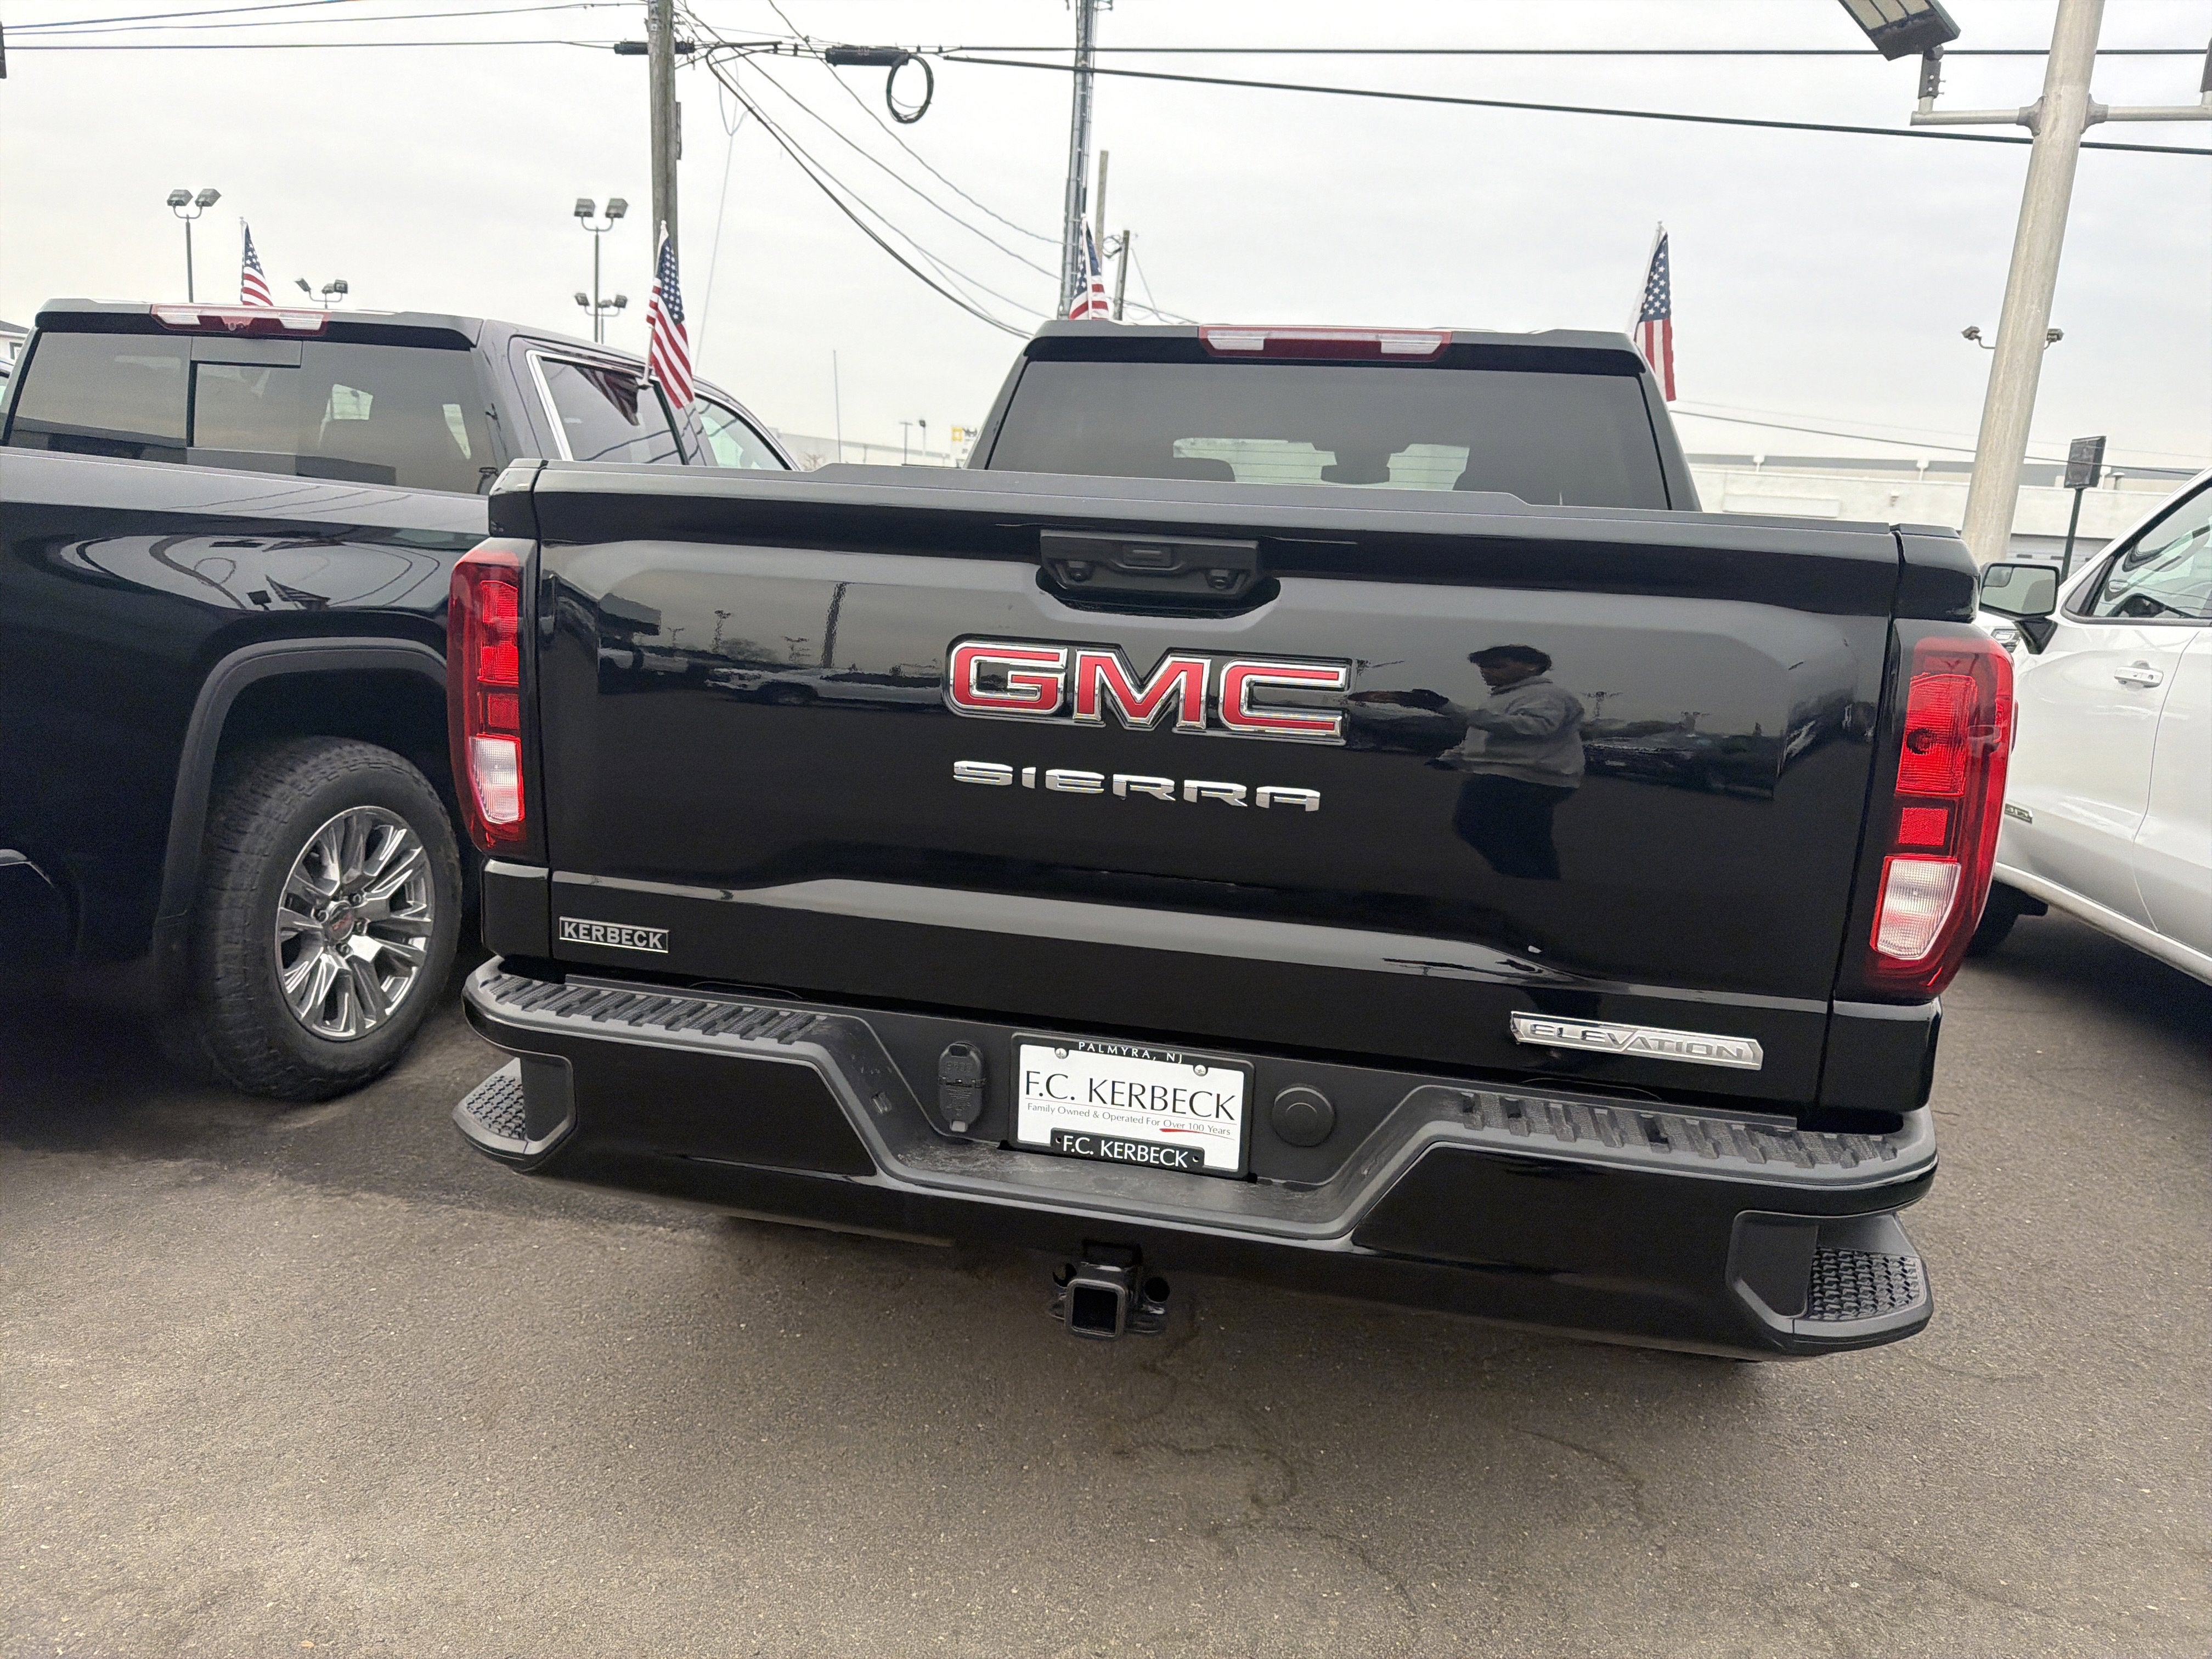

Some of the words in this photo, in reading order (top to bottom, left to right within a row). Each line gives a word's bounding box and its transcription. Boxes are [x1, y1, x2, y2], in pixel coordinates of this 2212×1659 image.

[949, 640, 1346, 738] GMC
[952, 760, 1321, 812] SIERRA
[563, 921, 663, 949] KERBECK
[1079, 1041, 1156, 1061] PALMYRA,
[1166, 1052, 1183, 1064] NJ
[1530, 1023, 1744, 1061] ELEVATION
[1025, 1070, 1075, 1101] F.C.
[1088, 1077, 1237, 1121] KERBECK
[1027, 1103, 1056, 1115] Family
[1057, 1106, 1090, 1118] Owned
[1092, 1110, 1099, 1119] &
[1102, 1111, 1144, 1124] Operated
[1146, 1117, 1161, 1126] For
[1163, 1119, 1186, 1129] Over
[1189, 1122, 1204, 1132] 100
[1207, 1125, 1231, 1136] Years
[1063, 1135, 1094, 1155] F.C.
[1101, 1139, 1189, 1169] KERBECK
